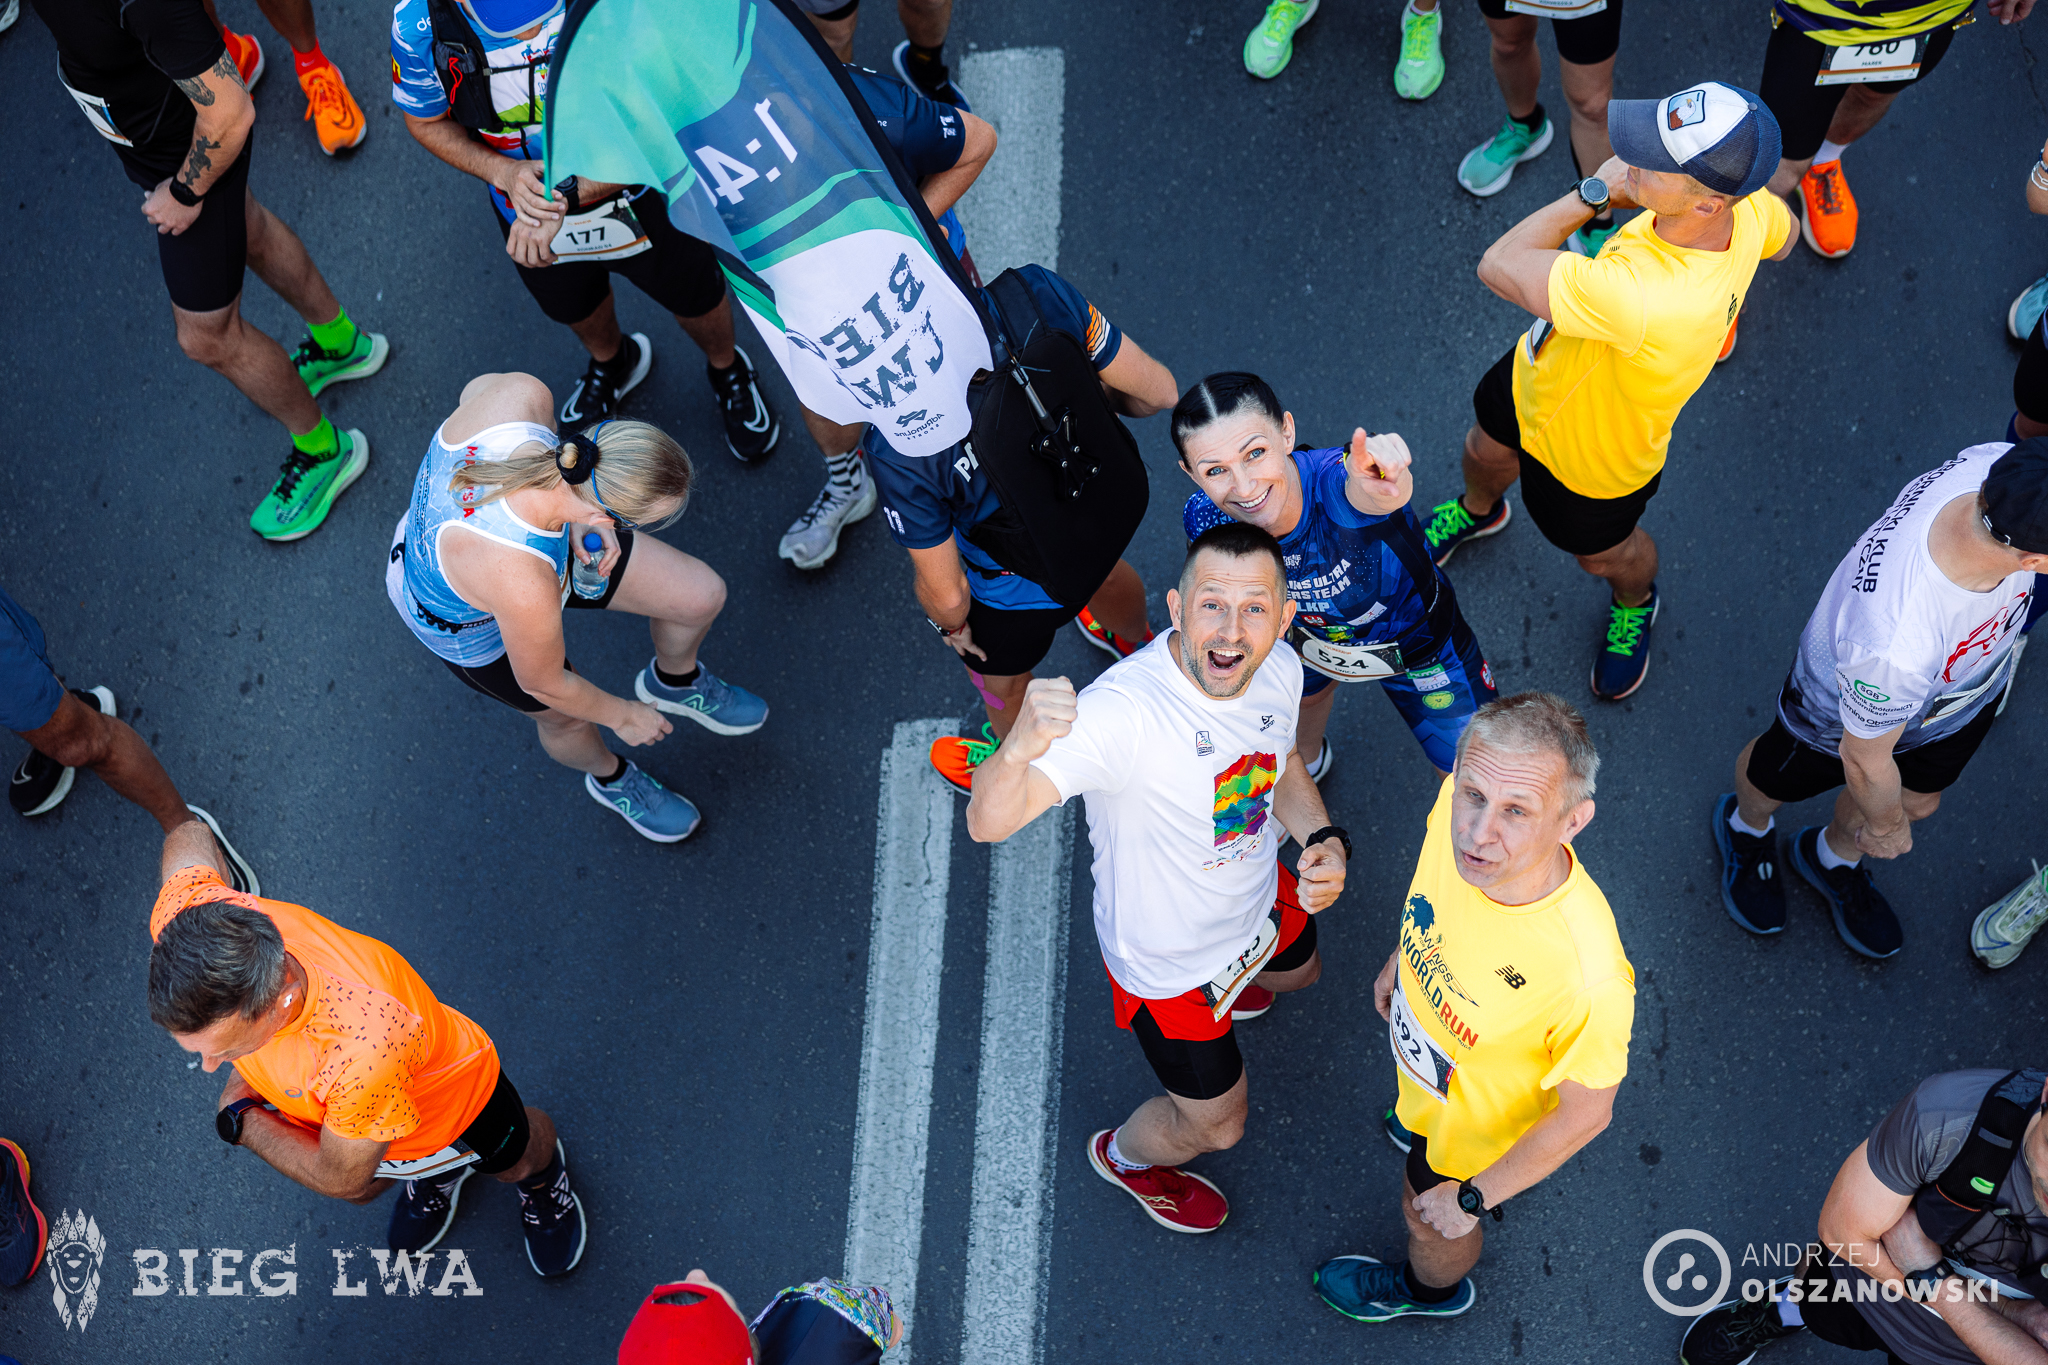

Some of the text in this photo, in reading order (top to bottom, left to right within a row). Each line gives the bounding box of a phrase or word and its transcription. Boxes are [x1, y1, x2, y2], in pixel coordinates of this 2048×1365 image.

[566, 226, 605, 245] 177
[1313, 558, 1351, 588] ULTRA
[1862, 538, 1889, 593] KLUB
[1312, 575, 1351, 599] TEAM
[1319, 648, 1369, 669] 524
[1860, 685, 1880, 700] SGB
[1842, 697, 1865, 722] Gmina
[1402, 927, 1480, 1047] WORLD RUN
[1394, 1004, 1422, 1063] 392
